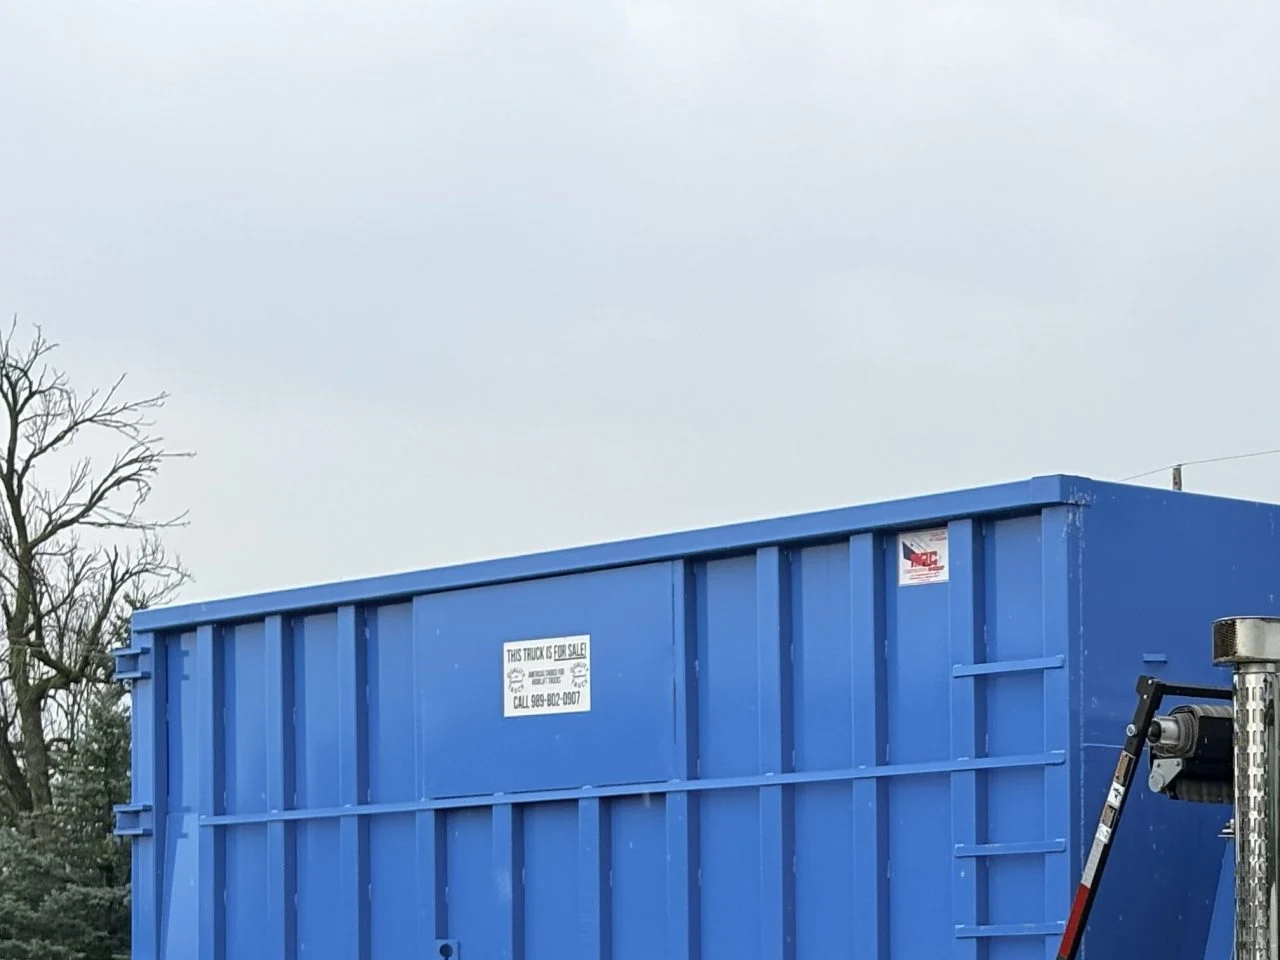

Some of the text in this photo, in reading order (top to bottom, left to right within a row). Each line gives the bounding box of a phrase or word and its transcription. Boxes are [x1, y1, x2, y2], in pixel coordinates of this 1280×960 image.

[507, 642, 587, 663] THIS TRUCK IS FOR SALE!
[513, 691, 581, 710] CALL 989-802-0907
